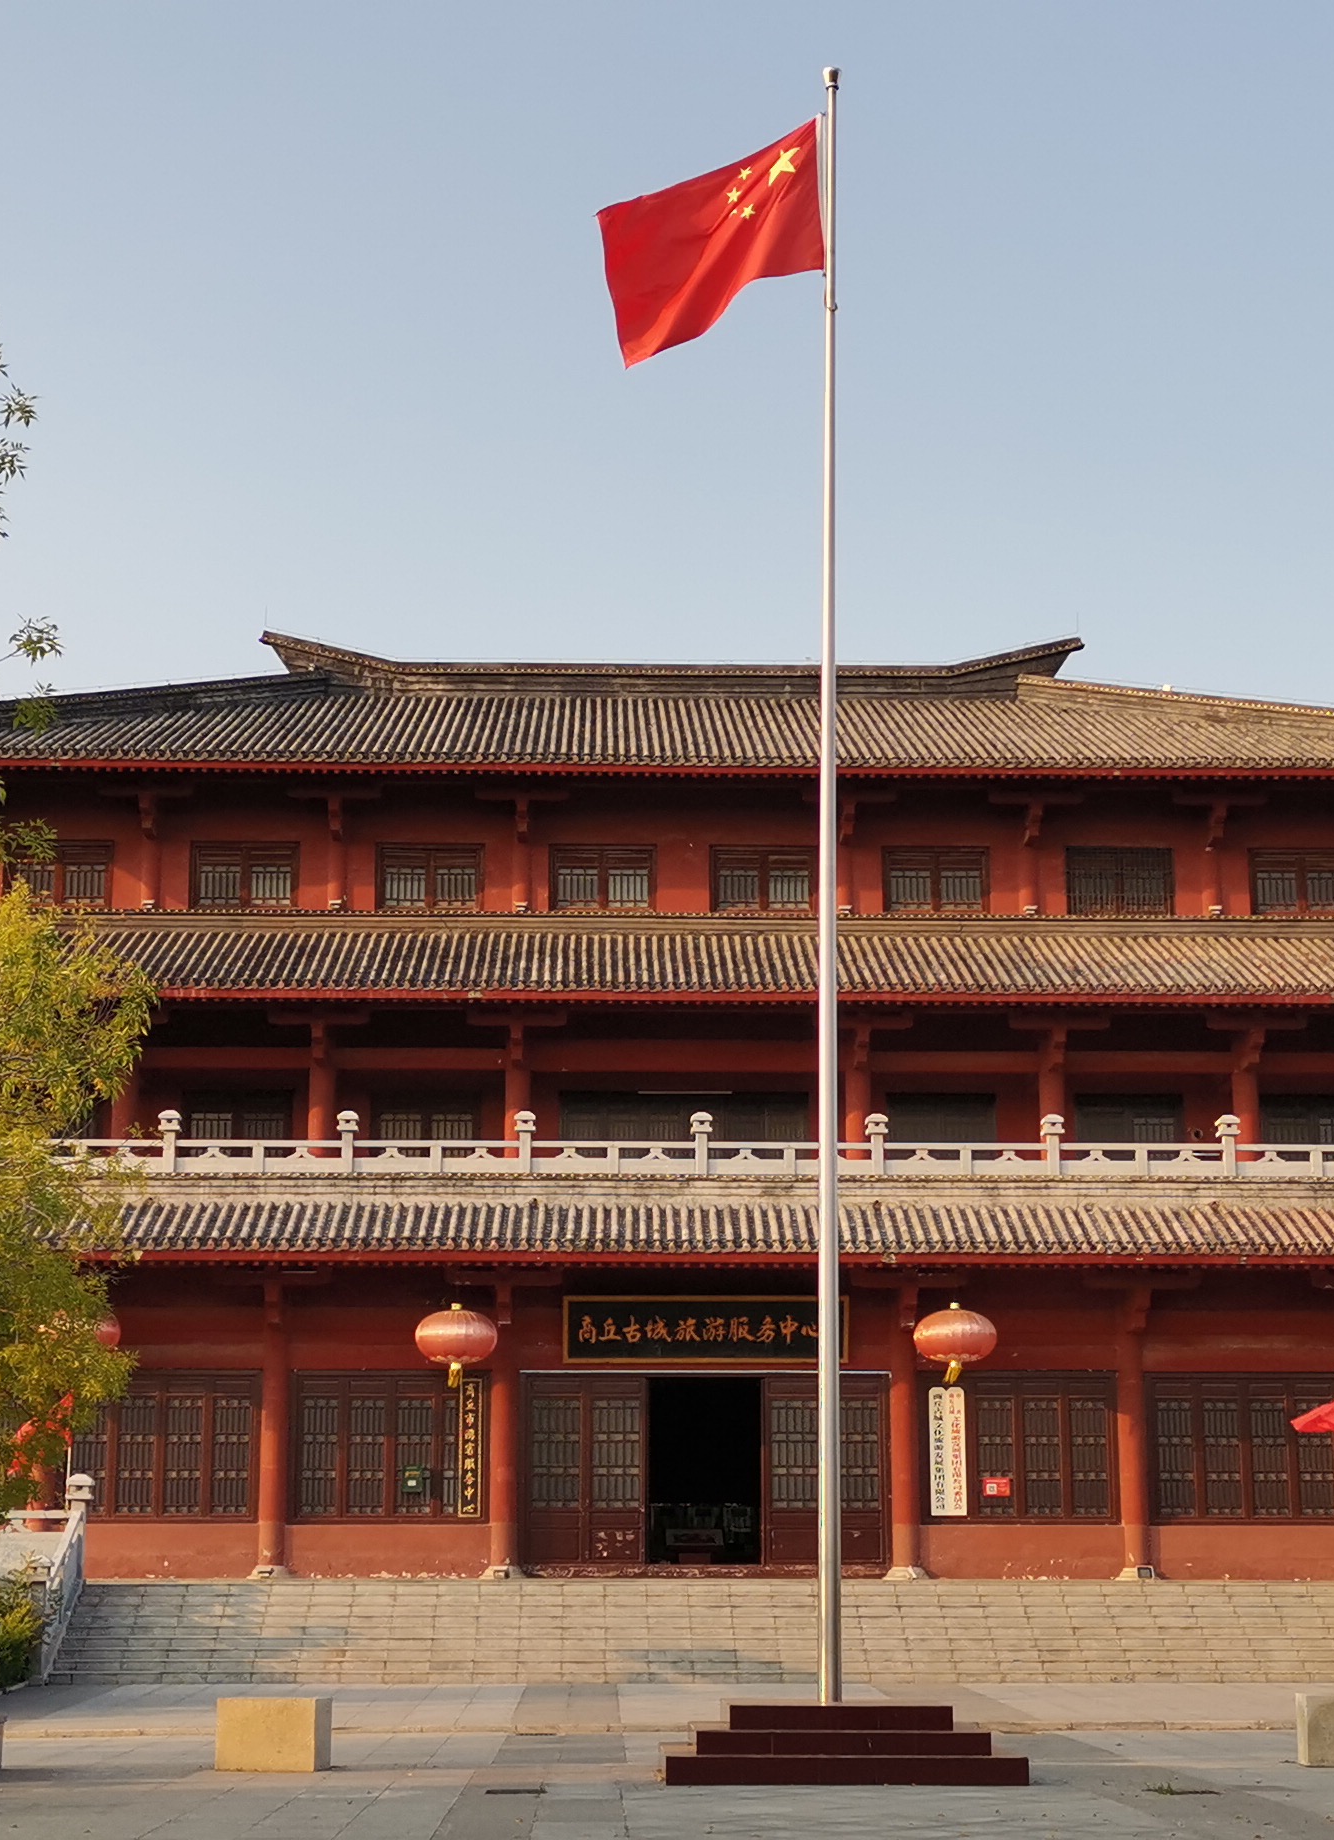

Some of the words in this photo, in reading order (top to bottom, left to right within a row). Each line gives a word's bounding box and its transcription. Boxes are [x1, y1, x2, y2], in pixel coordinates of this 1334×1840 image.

[578, 1314, 819, 1344] 商丘古城旅游服务中心
